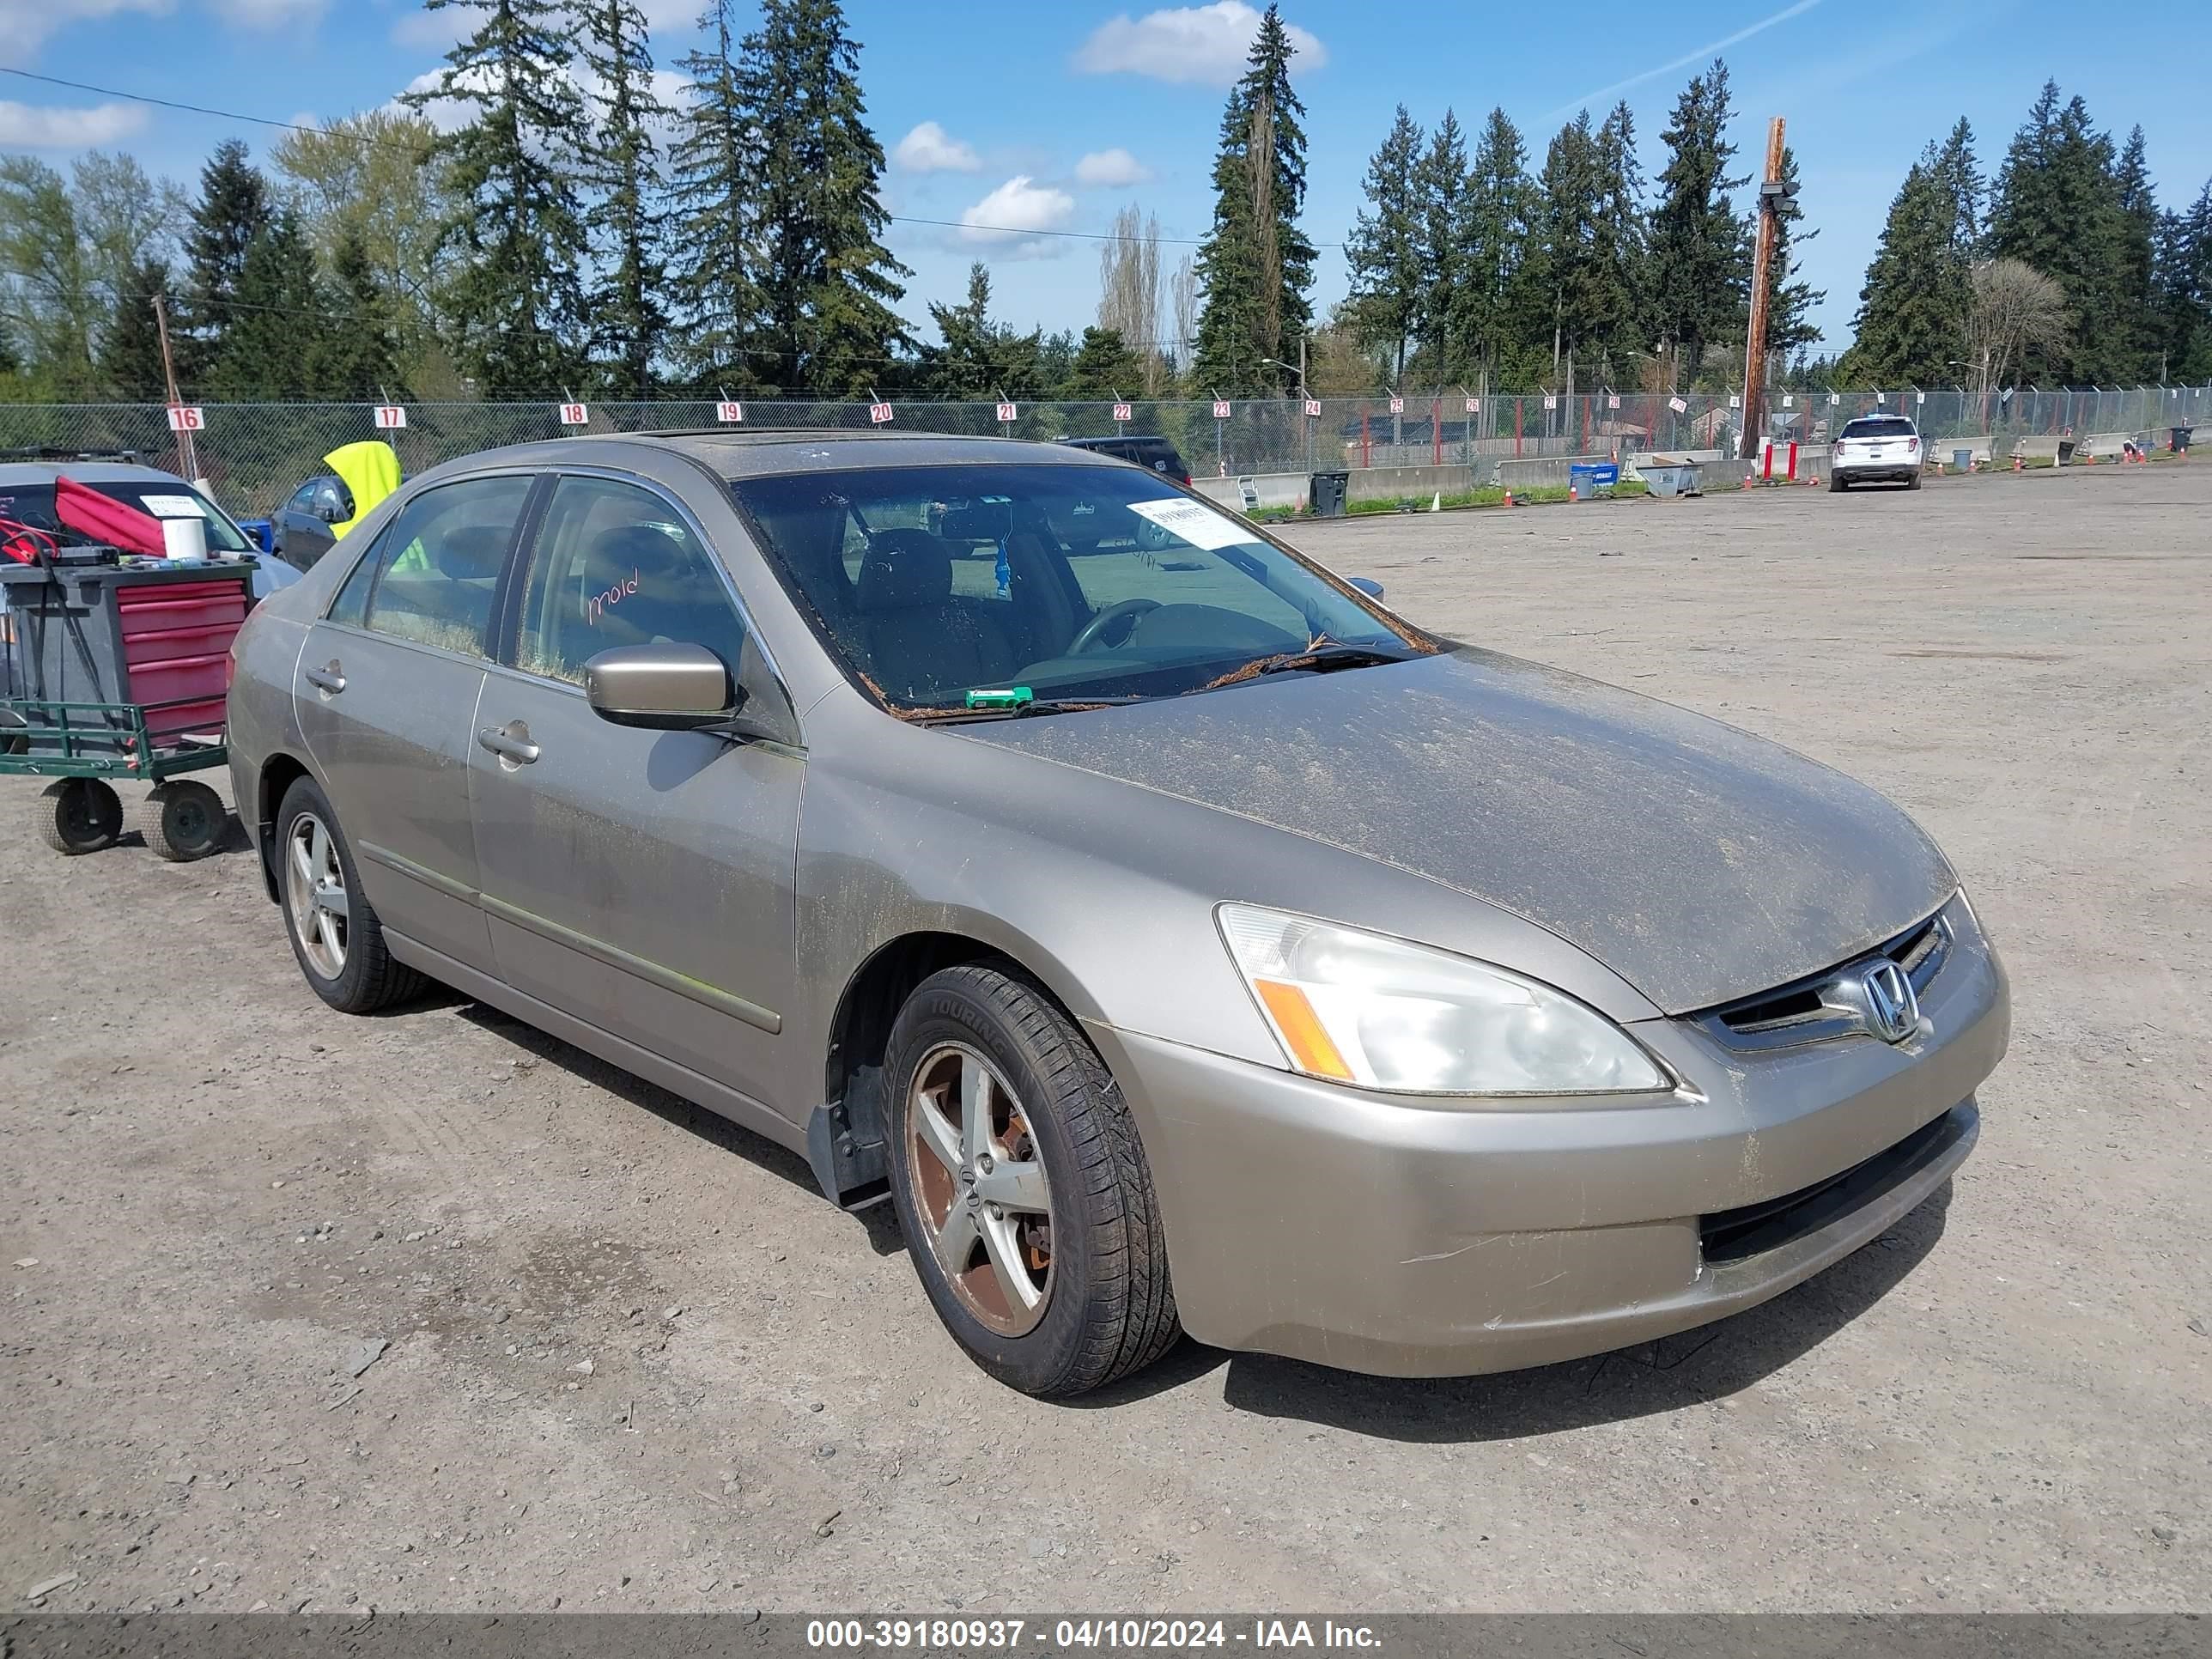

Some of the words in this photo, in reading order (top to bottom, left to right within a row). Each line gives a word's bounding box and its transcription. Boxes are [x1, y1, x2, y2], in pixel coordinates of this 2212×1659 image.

[1215, 403, 1228, 416] 23
[1307, 401, 1319, 414] 24
[1391, 399, 1401, 412] 25
[1467, 399, 1478, 411] 26
[1546, 398, 1555, 409] 27
[1610, 397, 1620, 409] 28
[1670, 398, 1685, 411] 29
[173, 410, 198, 428] 16
[382, 409, 398, 426] 17
[565, 405, 583, 422] 18
[722, 404, 737, 420] 19
[872, 404, 890, 422] 20
[1001, 404, 1013, 420] 21
[1115, 404, 1128, 420] 22
[588, 567, 638, 626] mold
[932, 999, 1006, 1056] TOURING
